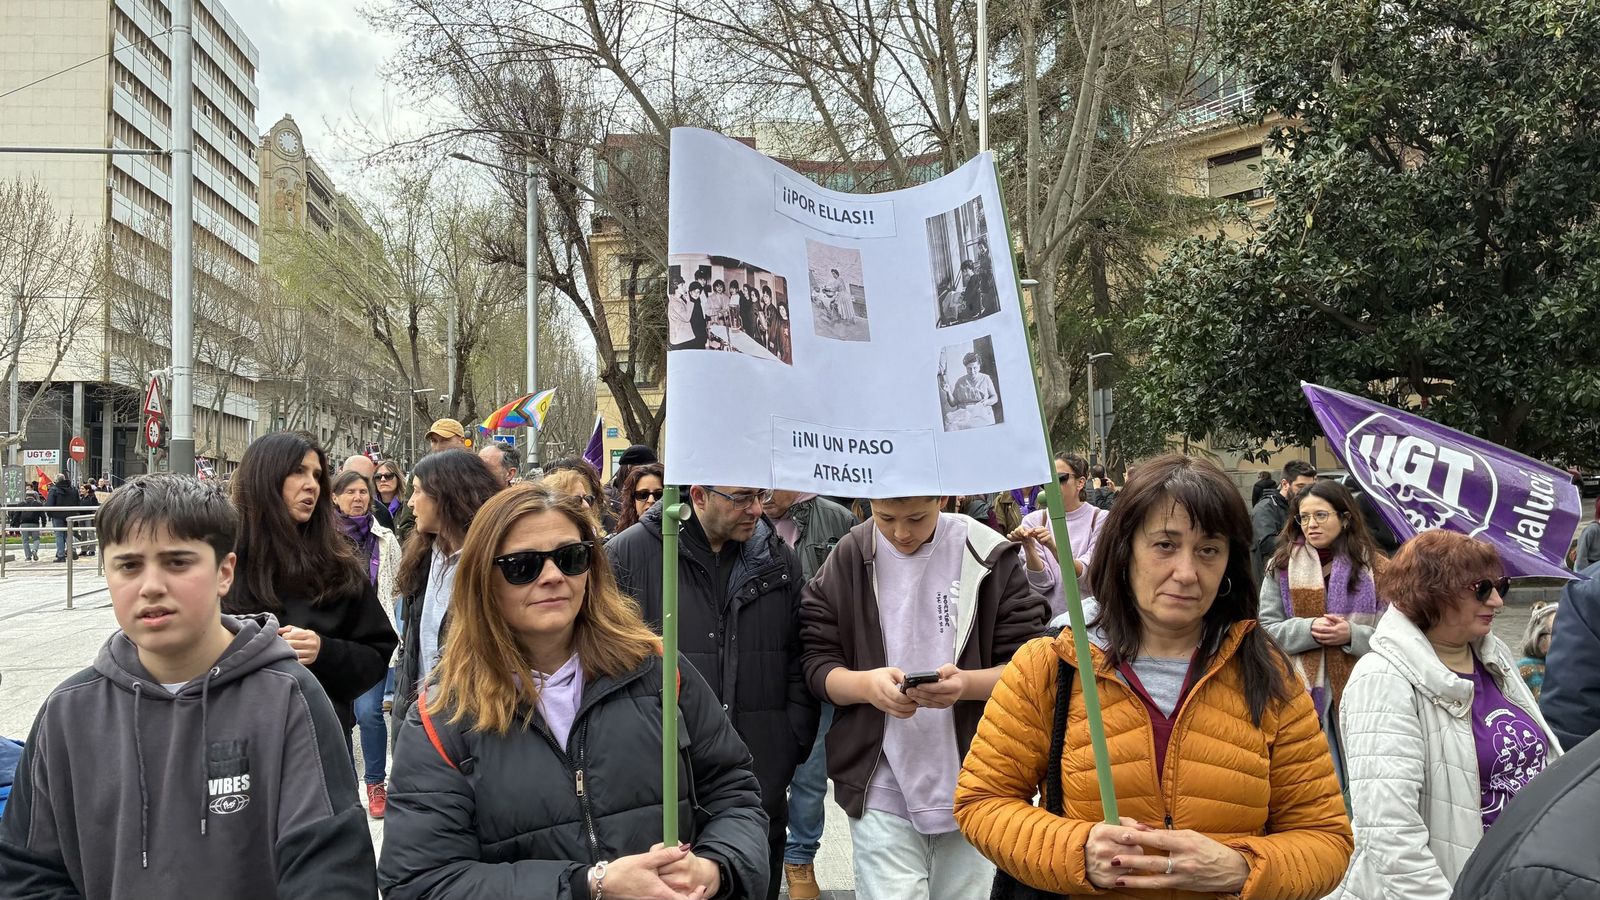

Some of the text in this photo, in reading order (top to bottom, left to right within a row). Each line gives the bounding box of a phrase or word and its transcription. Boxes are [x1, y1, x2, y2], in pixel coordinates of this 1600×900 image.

[783, 186, 875, 225] ¡¡POR ELLAS!!
[792, 430, 894, 455] ¡¡NI UN PASO
[813, 463, 873, 484] ATRÁS!!
[1358, 434, 1475, 509] UGT
[208, 774, 250, 795] VIBES
